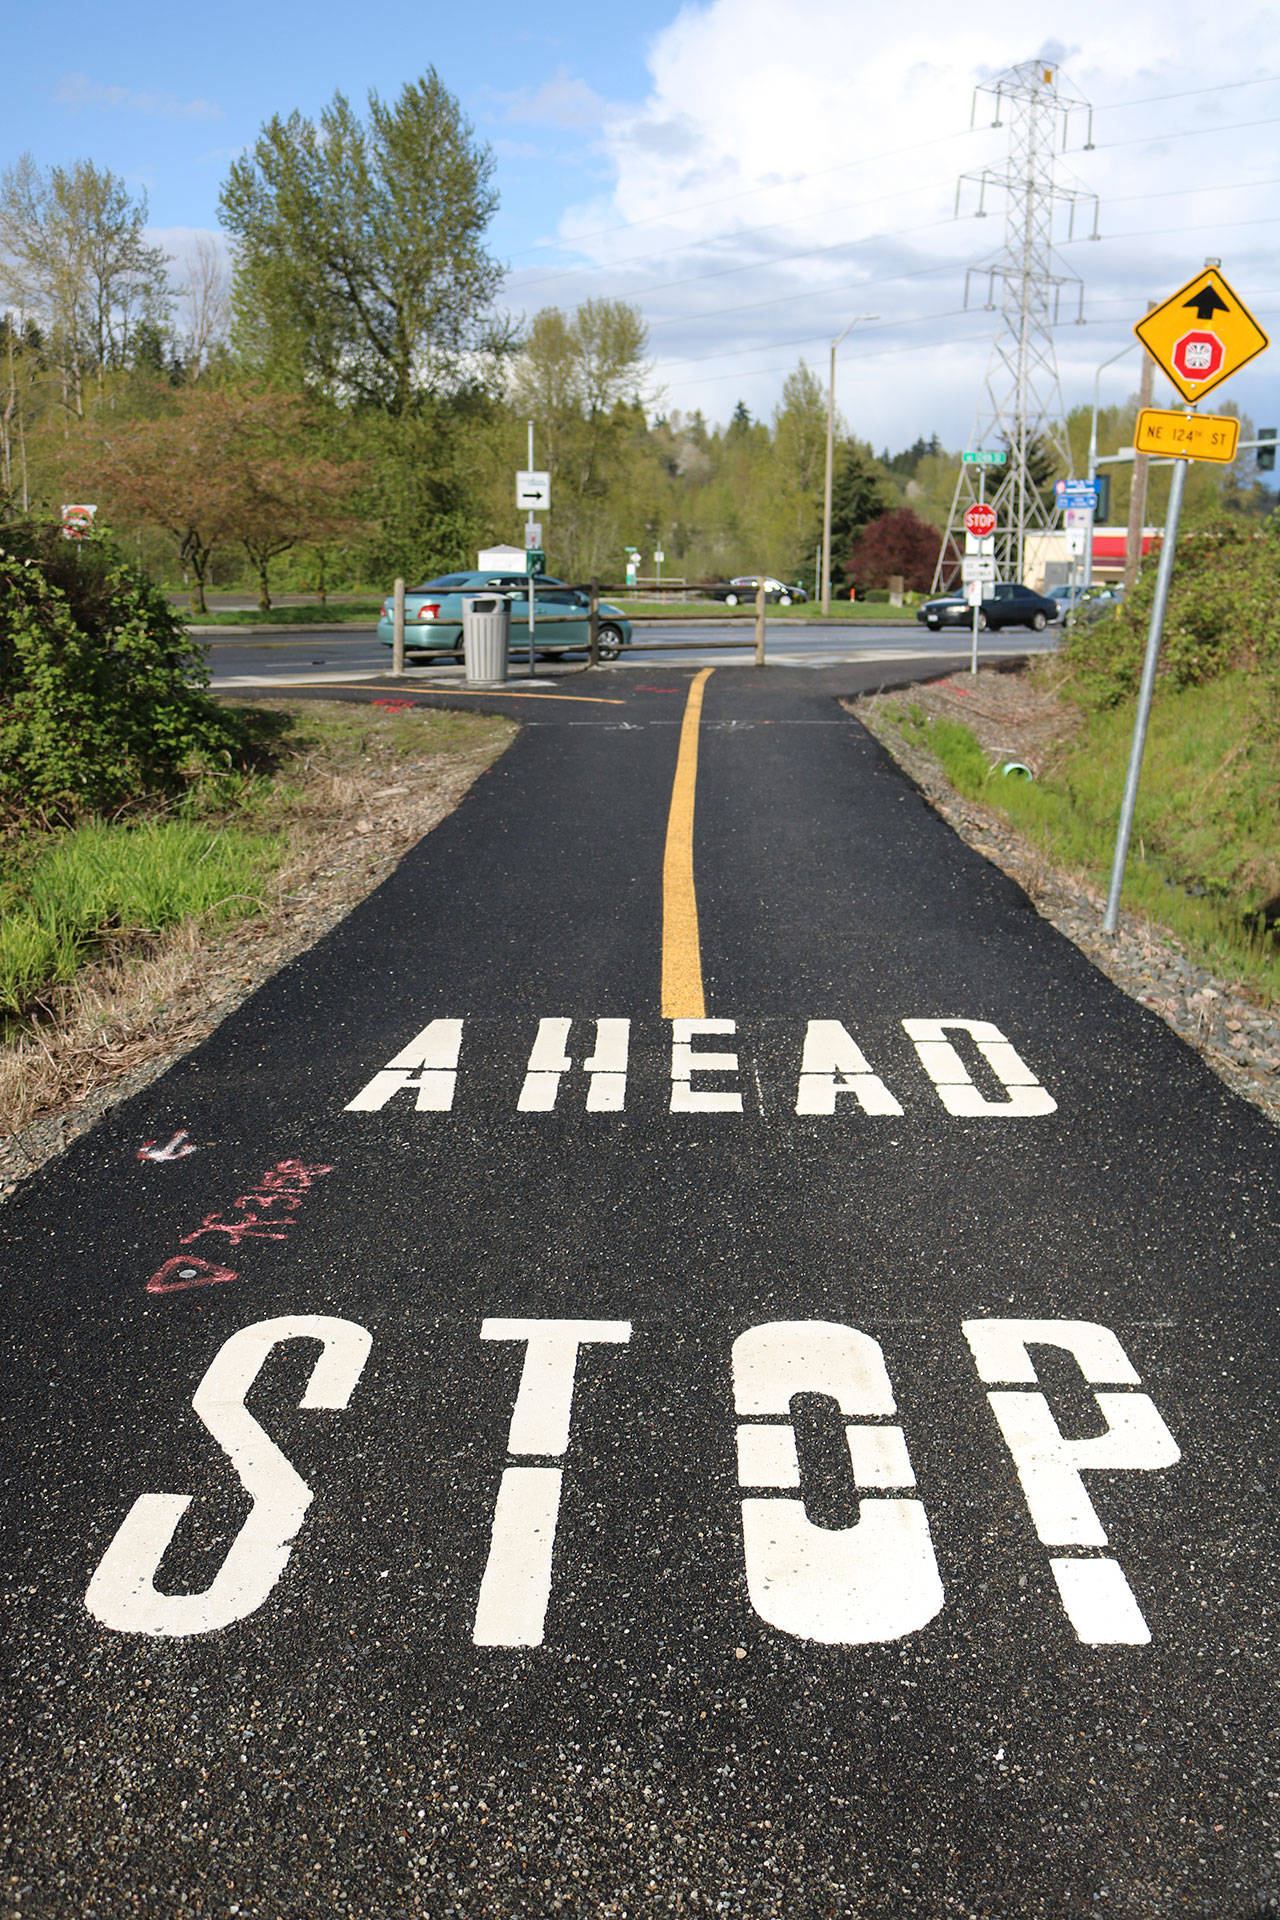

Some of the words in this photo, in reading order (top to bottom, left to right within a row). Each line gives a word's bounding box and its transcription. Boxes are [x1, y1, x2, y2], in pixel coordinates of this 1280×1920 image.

[1147, 426, 1164, 439] NE
[1210, 432, 1227, 446] ST
[967, 513, 996, 527] STOP
[344, 1016, 1058, 1117] AHEAD
[84, 1313, 1181, 1650] STOP
